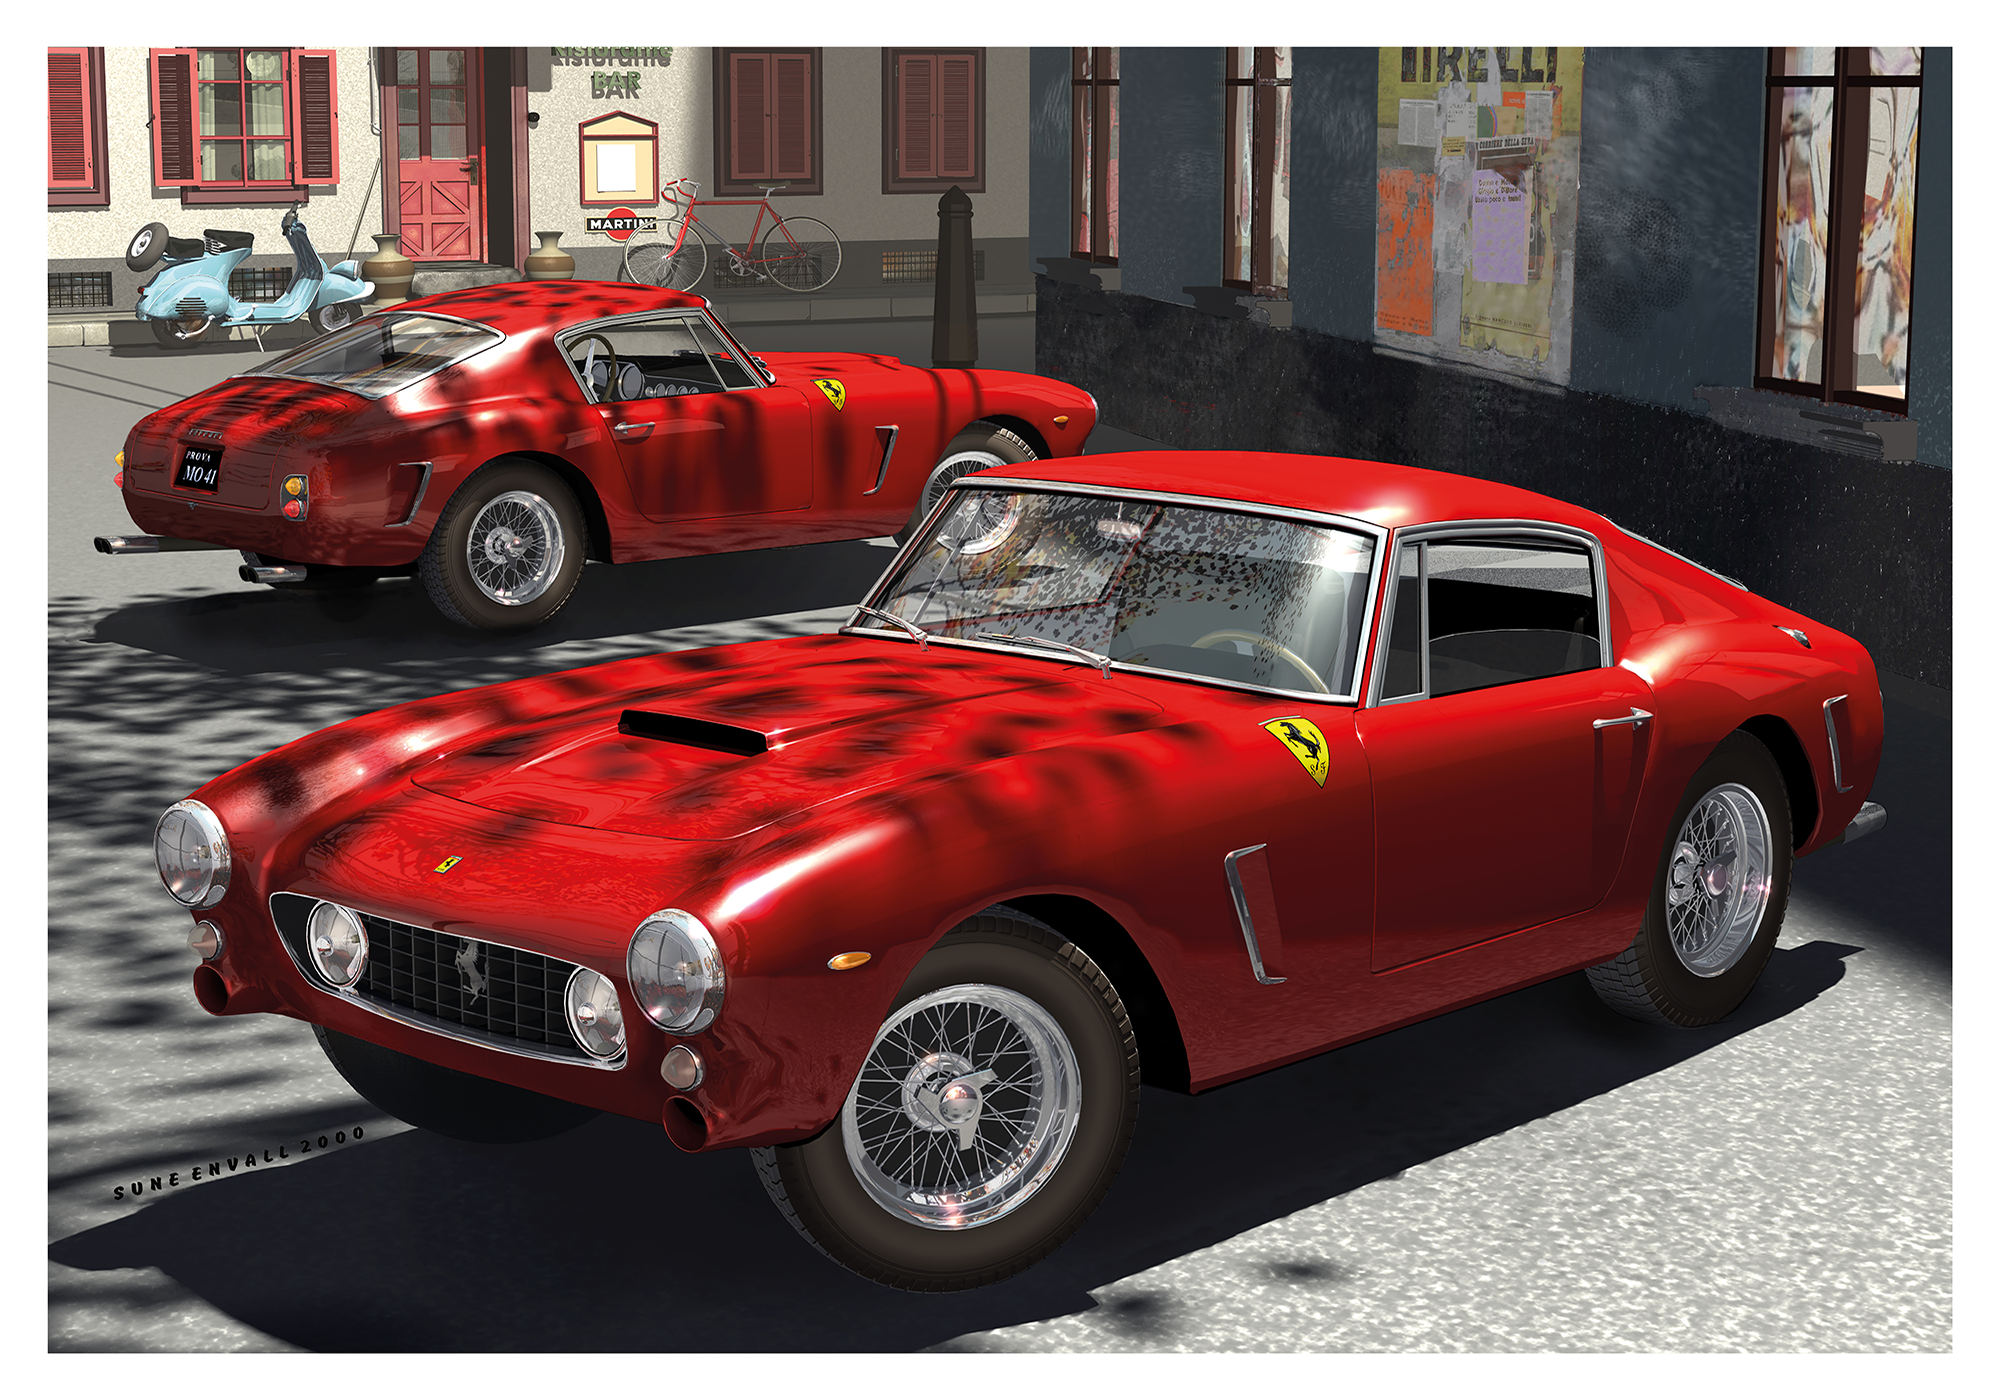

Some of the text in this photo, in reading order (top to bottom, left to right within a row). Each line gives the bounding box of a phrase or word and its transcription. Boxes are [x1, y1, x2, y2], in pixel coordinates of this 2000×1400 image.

[592, 70, 642, 90] BAR
[1479, 136, 1534, 149] CORRIERE DELLA SERA
[590, 218, 656, 230] MARTINI
[186, 450, 211, 462] PROVA
[183, 465, 217, 485] MO 41
